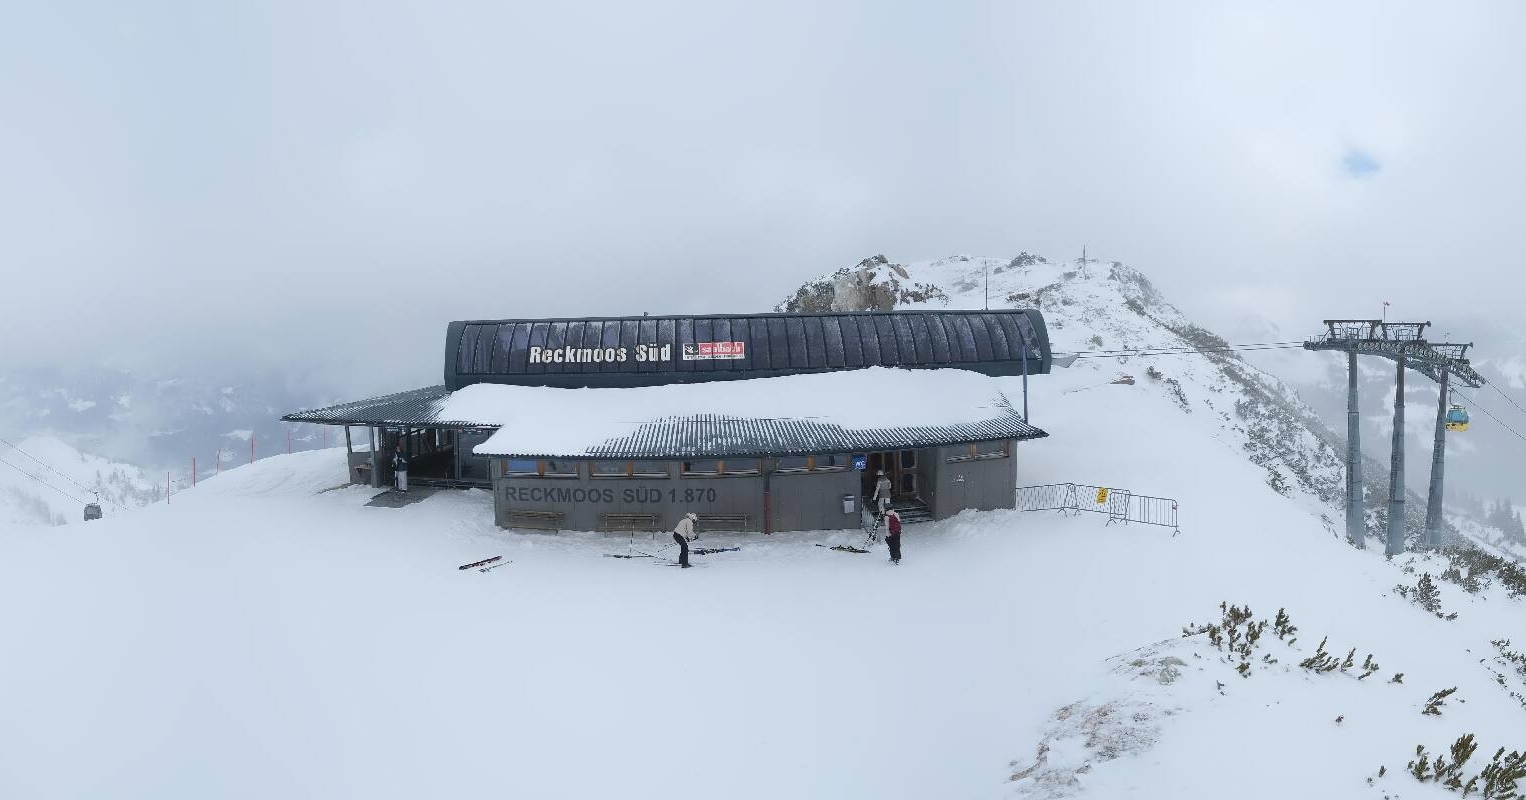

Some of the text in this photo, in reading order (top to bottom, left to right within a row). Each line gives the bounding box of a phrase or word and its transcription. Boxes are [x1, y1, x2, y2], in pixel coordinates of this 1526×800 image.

[529, 343, 671, 363] Reckmoos Süd
[505, 486, 717, 503] RECKMOOS SÜD 1.870
